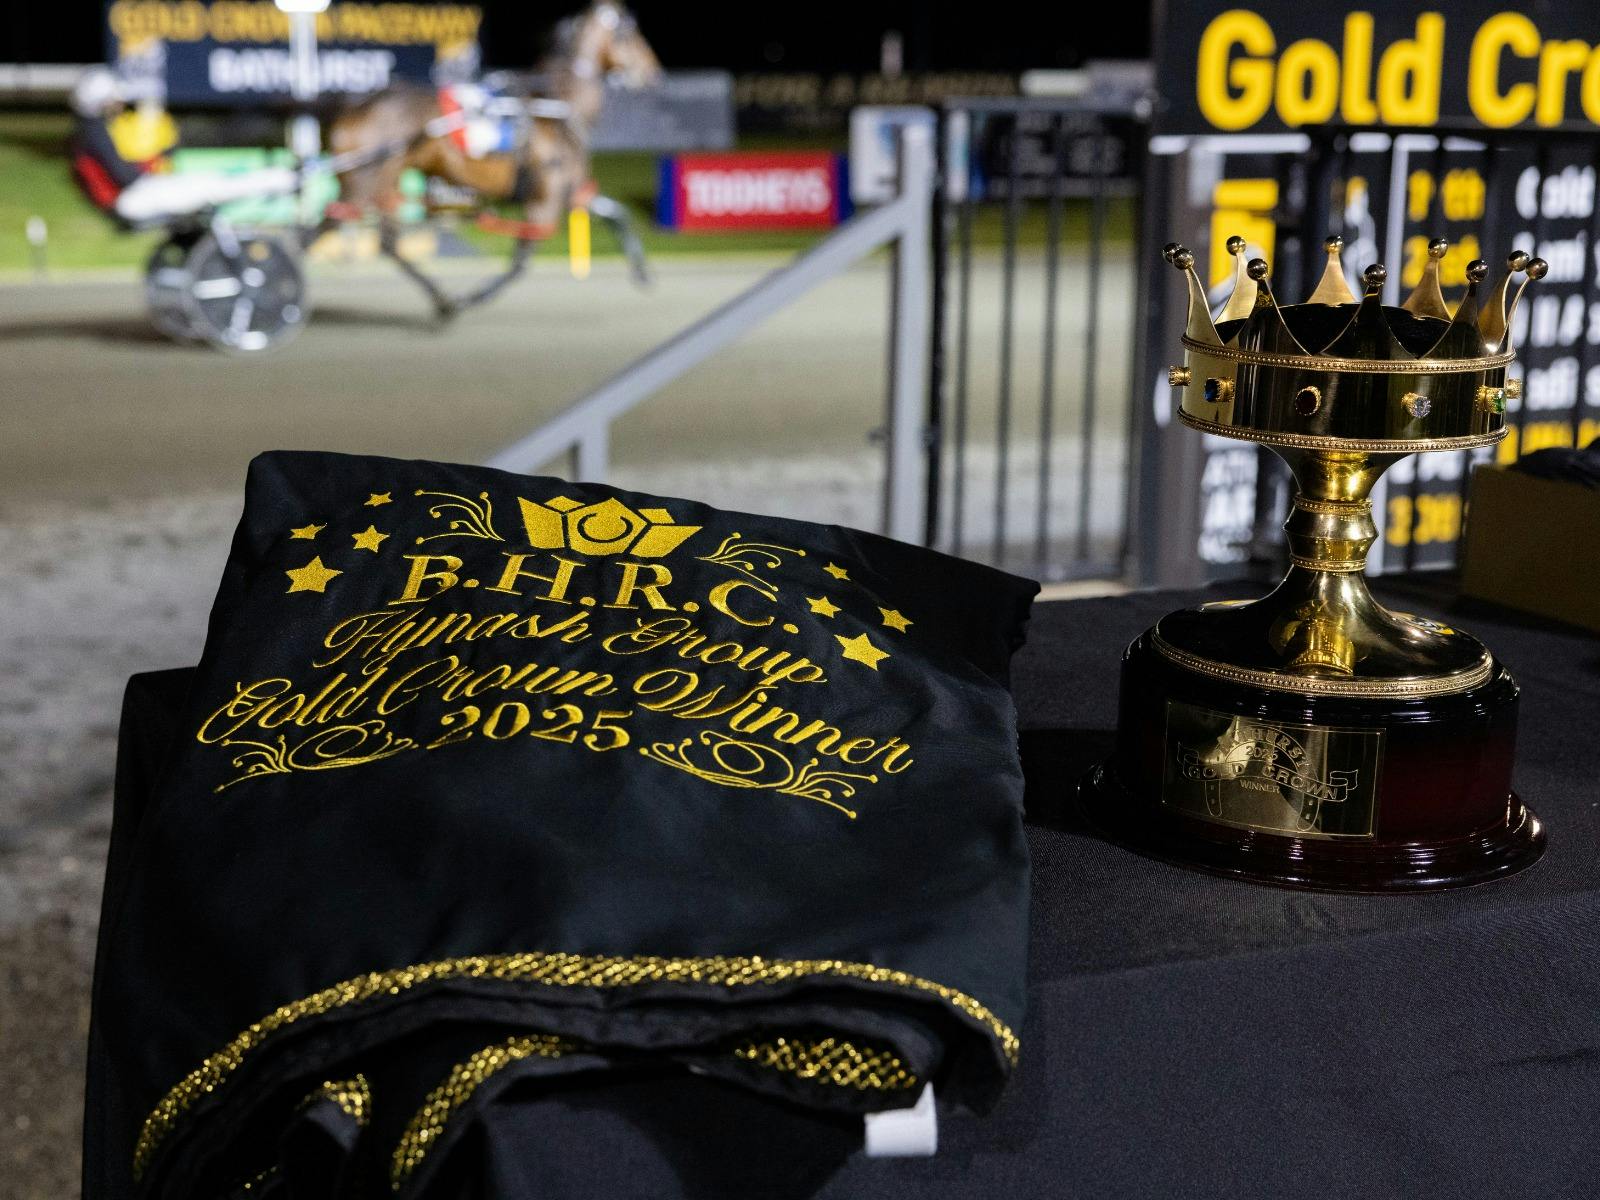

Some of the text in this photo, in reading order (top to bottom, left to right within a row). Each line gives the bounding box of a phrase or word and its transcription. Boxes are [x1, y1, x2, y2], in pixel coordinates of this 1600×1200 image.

[1196, 9, 1445, 131] Gold
[685, 168, 831, 216] TOOHEYS
[388, 551, 799, 635] B.H.R.C.
[313, 609, 826, 686] Hynash Group
[195, 654, 914, 774] Gold Crown Winner
[426, 701, 633, 752] 2025
[1239, 778, 1281, 794] WINNER
[1261, 764, 1338, 800] CROWN
